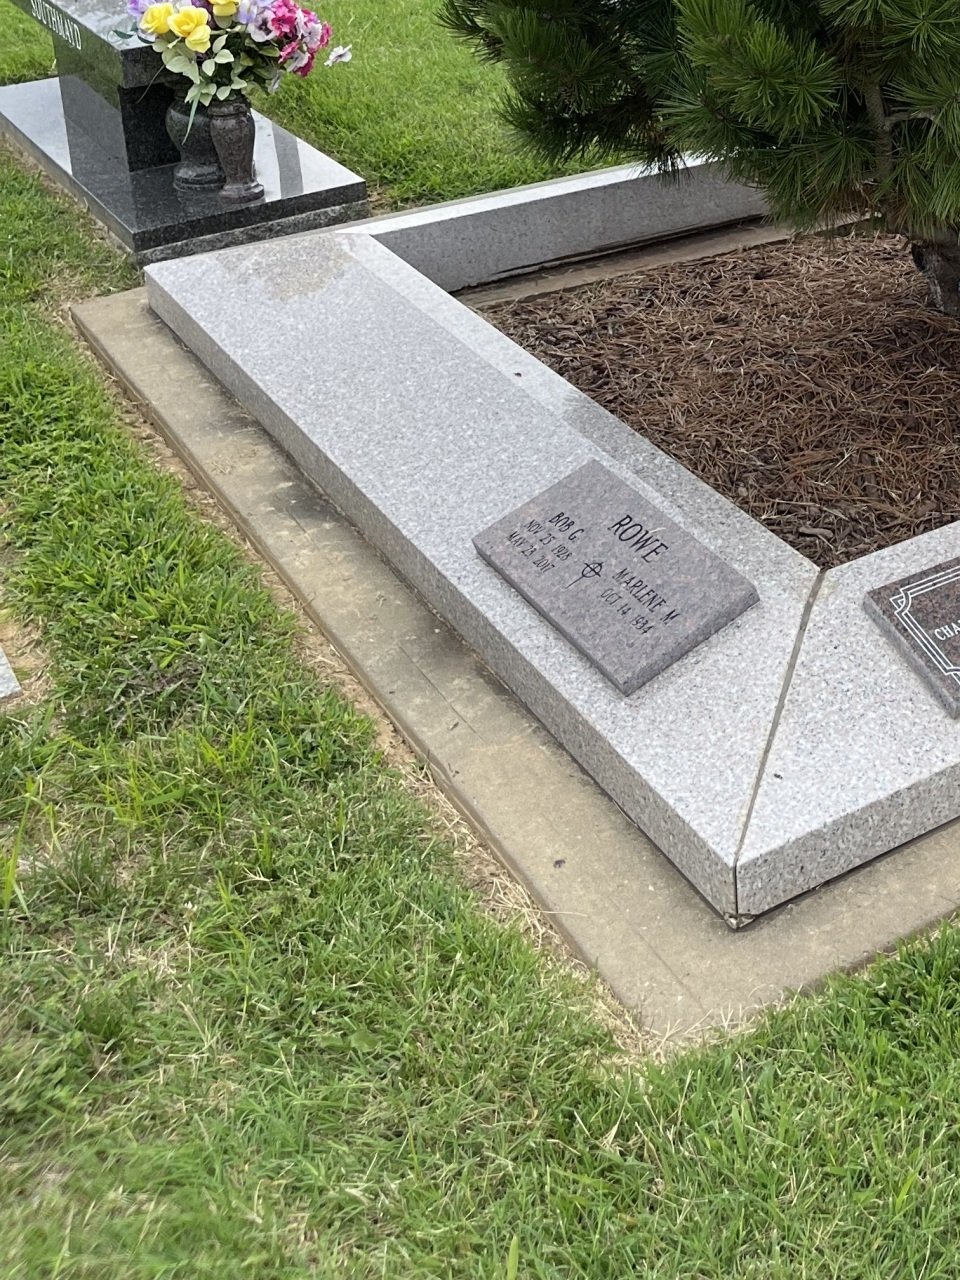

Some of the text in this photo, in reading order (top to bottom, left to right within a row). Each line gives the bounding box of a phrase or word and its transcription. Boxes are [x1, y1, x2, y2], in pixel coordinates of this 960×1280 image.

[548, 511, 575, 533] BOB
[607, 514, 668, 563] ROWE
[612, 567, 667, 613] MARLENE
